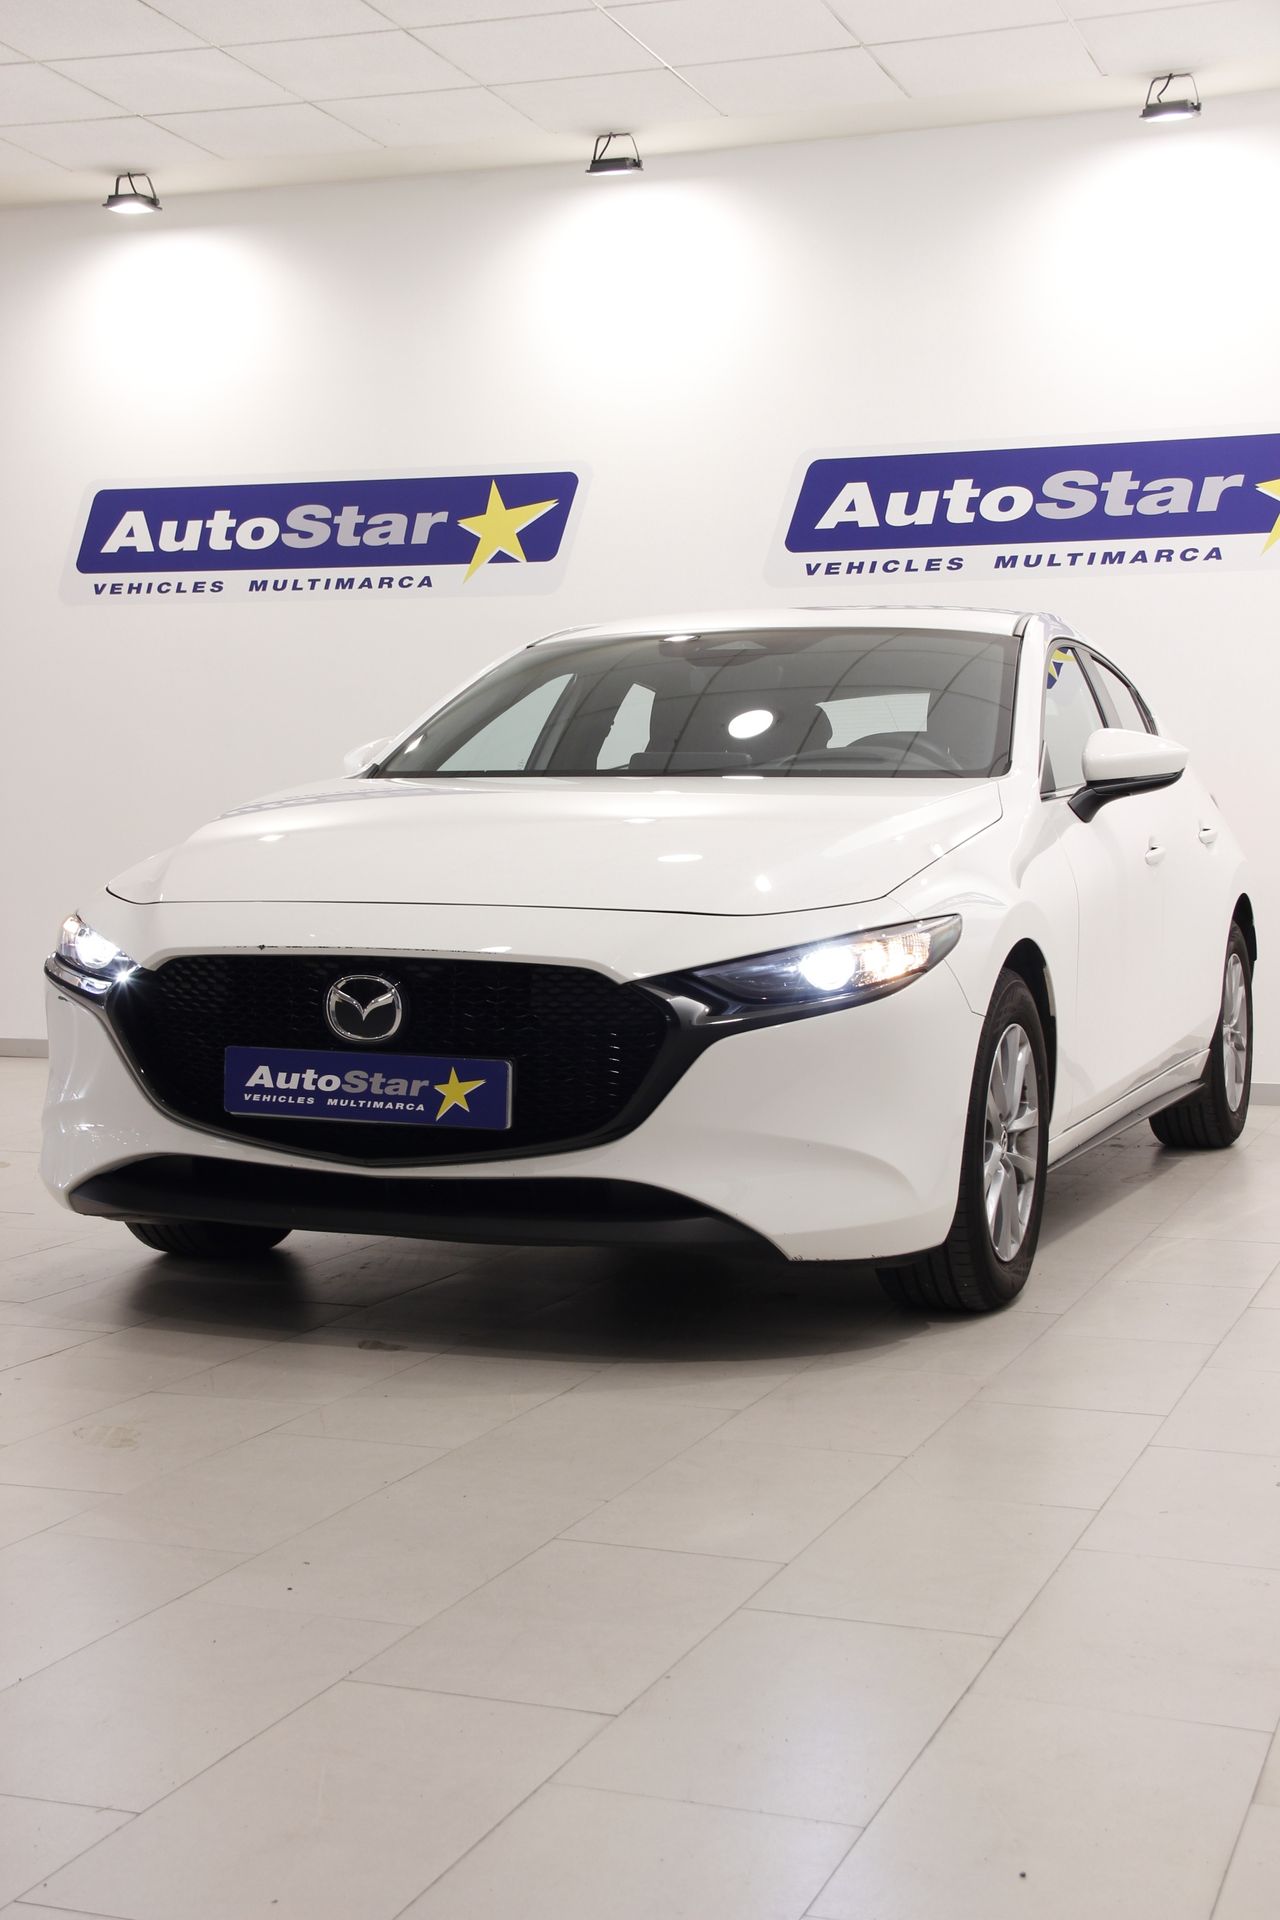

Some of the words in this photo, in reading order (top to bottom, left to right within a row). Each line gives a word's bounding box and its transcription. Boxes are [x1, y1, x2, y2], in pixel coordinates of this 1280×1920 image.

[814, 470, 1245, 529] AutoStar
[101, 504, 449, 553] AutoStar
[805, 557, 965, 576] VEHICLES
[994, 547, 1223, 570] MULTIMARCA
[93, 580, 225, 595] VEHICLES
[248, 576, 433, 592] MULTIMARCA
[245, 1065, 429, 1097] AutoStar
[243, 1093, 315, 1105] VEHICLES
[327, 1098, 425, 1112] MULTIMARCA
